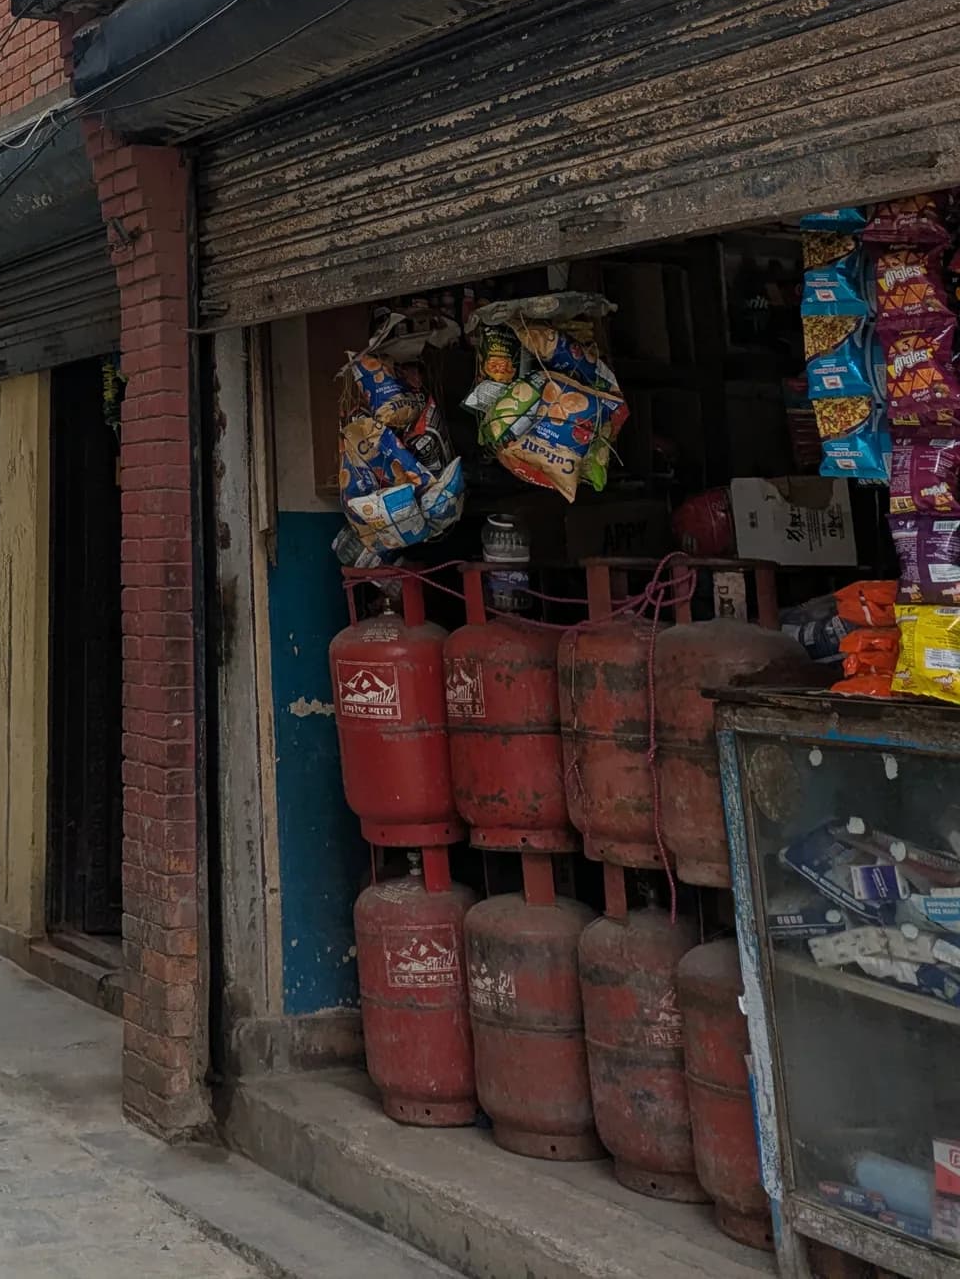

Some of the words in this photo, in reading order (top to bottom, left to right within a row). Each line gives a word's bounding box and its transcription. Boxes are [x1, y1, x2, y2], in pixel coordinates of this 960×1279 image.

[885, 265, 921, 290] Angles
[902, 339, 910, 352] 3
[894, 349, 928, 377] Angles
[520, 438, 576, 474] Current
